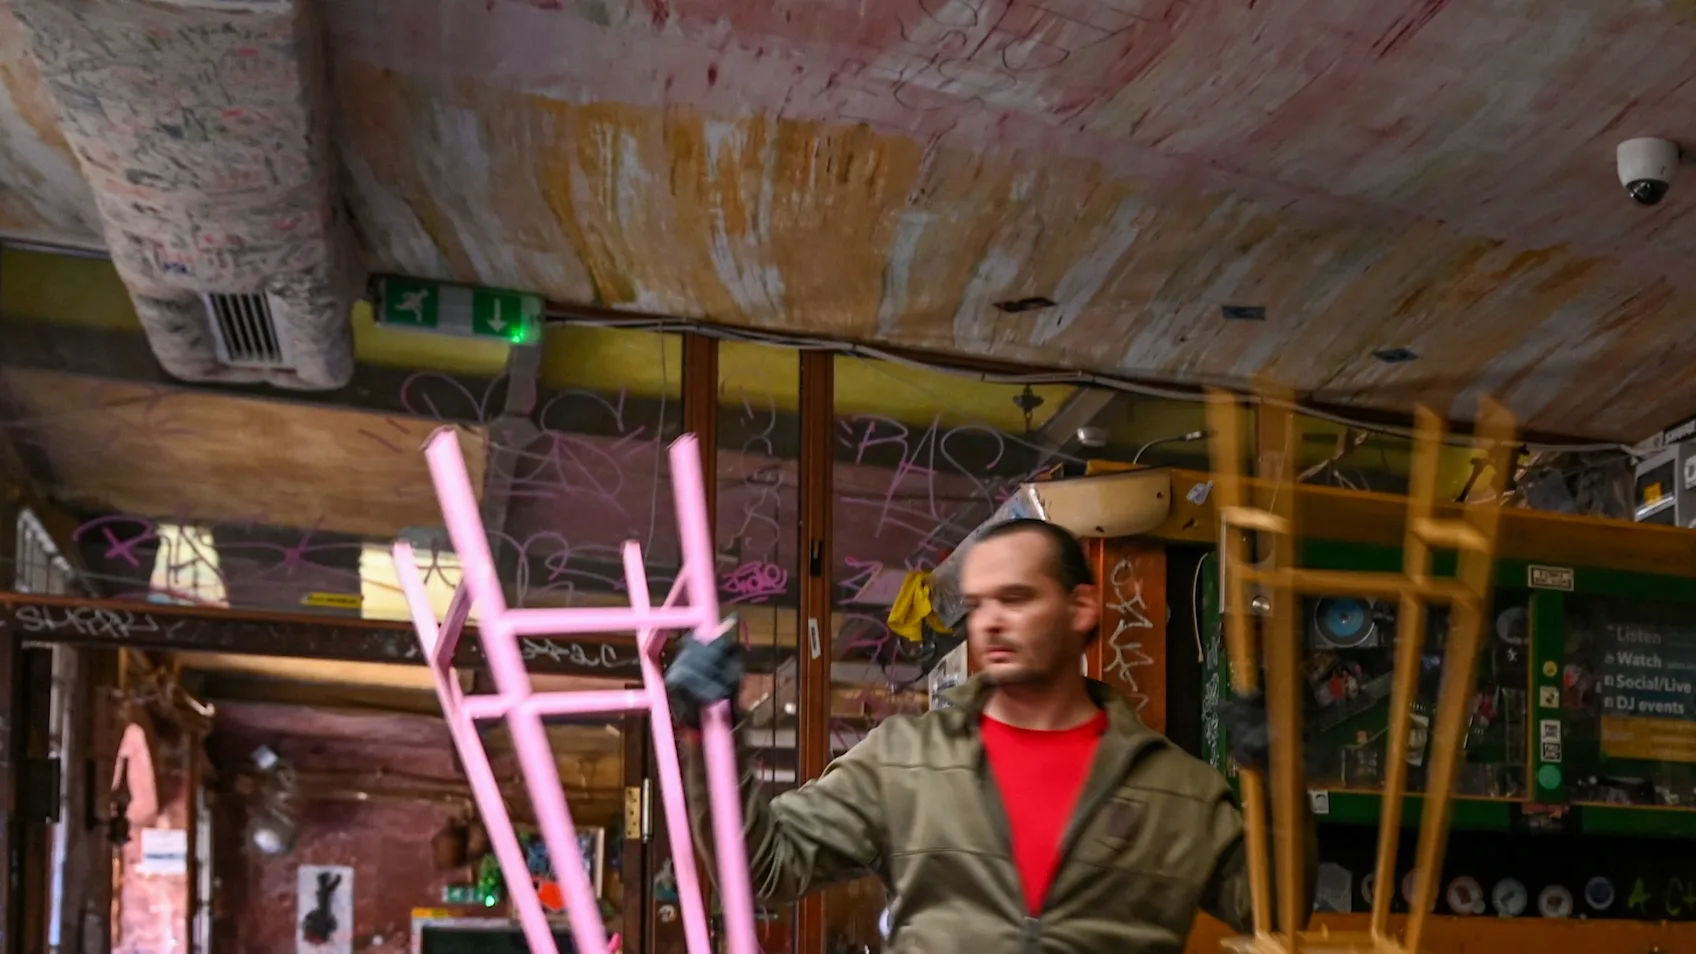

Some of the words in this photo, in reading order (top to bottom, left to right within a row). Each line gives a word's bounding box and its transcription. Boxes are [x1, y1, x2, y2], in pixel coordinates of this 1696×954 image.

[1616, 625, 1663, 646] Listen
[1616, 651, 1663, 670] Watch
[1616, 673, 1693, 694] Social/Live
[1616, 696, 1636, 711] DJ
[1638, 697, 1685, 715] events
